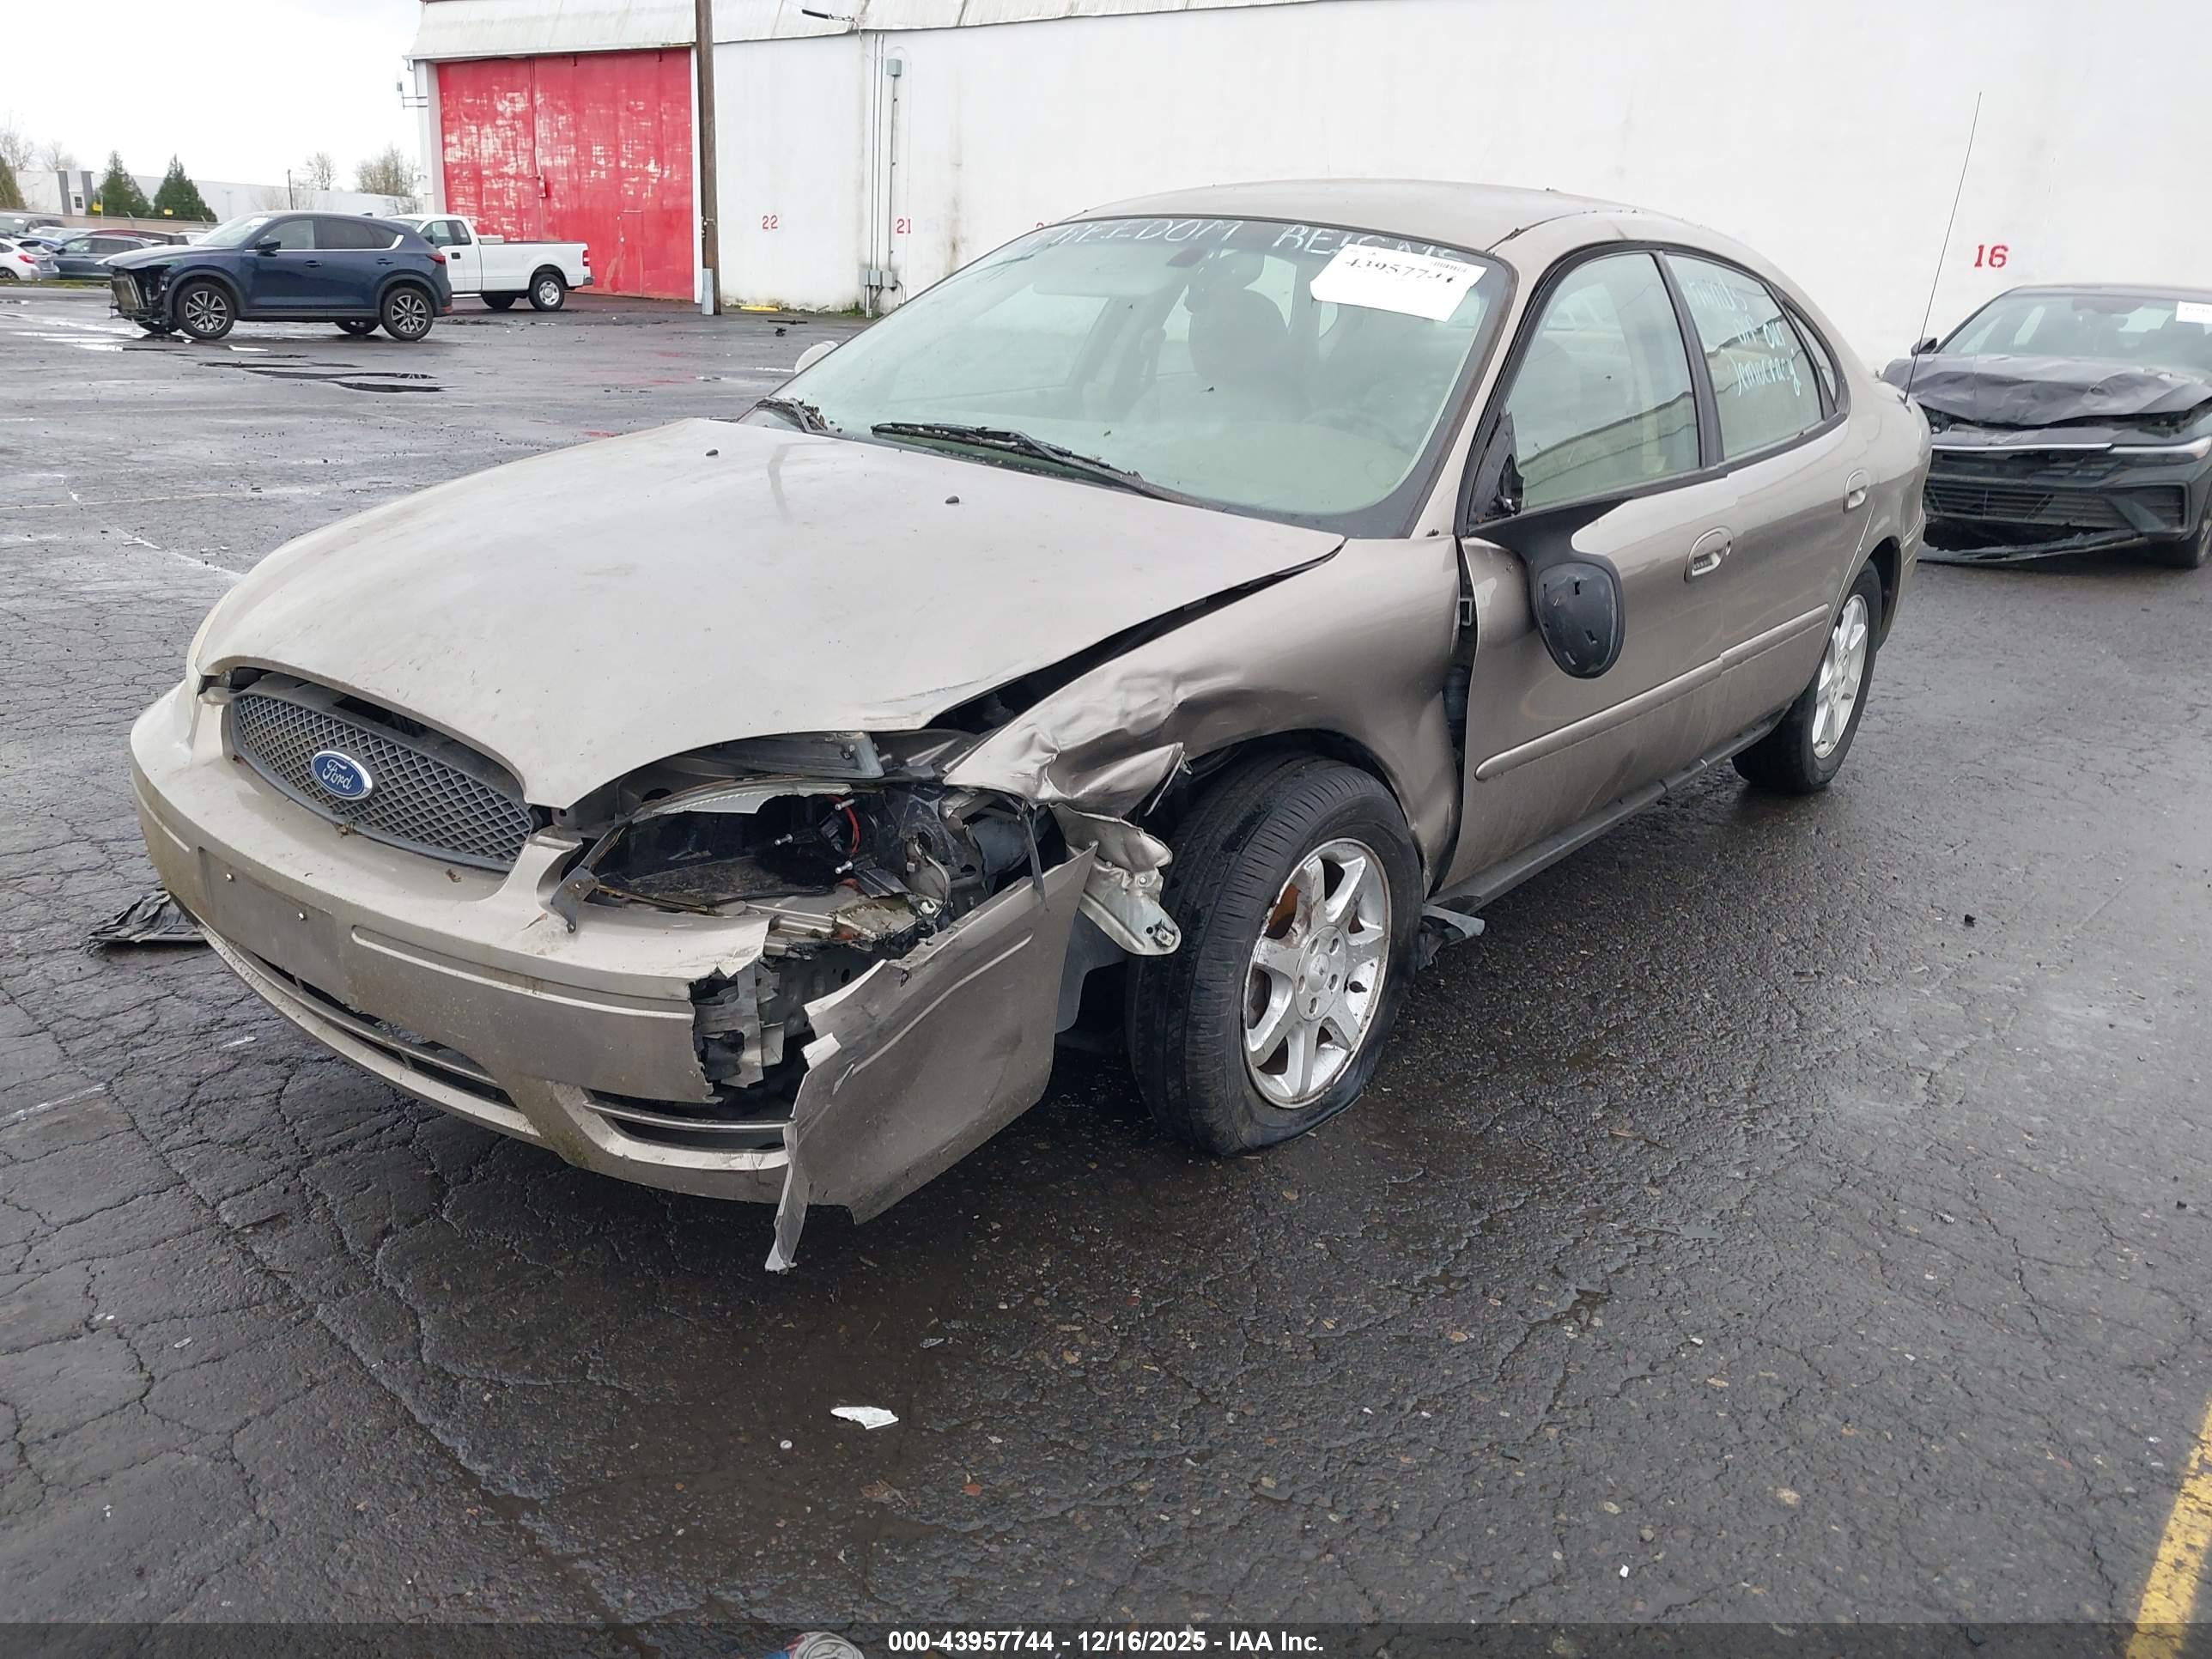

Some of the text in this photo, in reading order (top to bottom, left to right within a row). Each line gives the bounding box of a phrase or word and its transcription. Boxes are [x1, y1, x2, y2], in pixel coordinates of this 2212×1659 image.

[762, 215, 779, 230] 22
[896, 218, 912, 234] 21
[1974, 244, 2009, 269] 16
[322, 759, 354, 790] Ford
